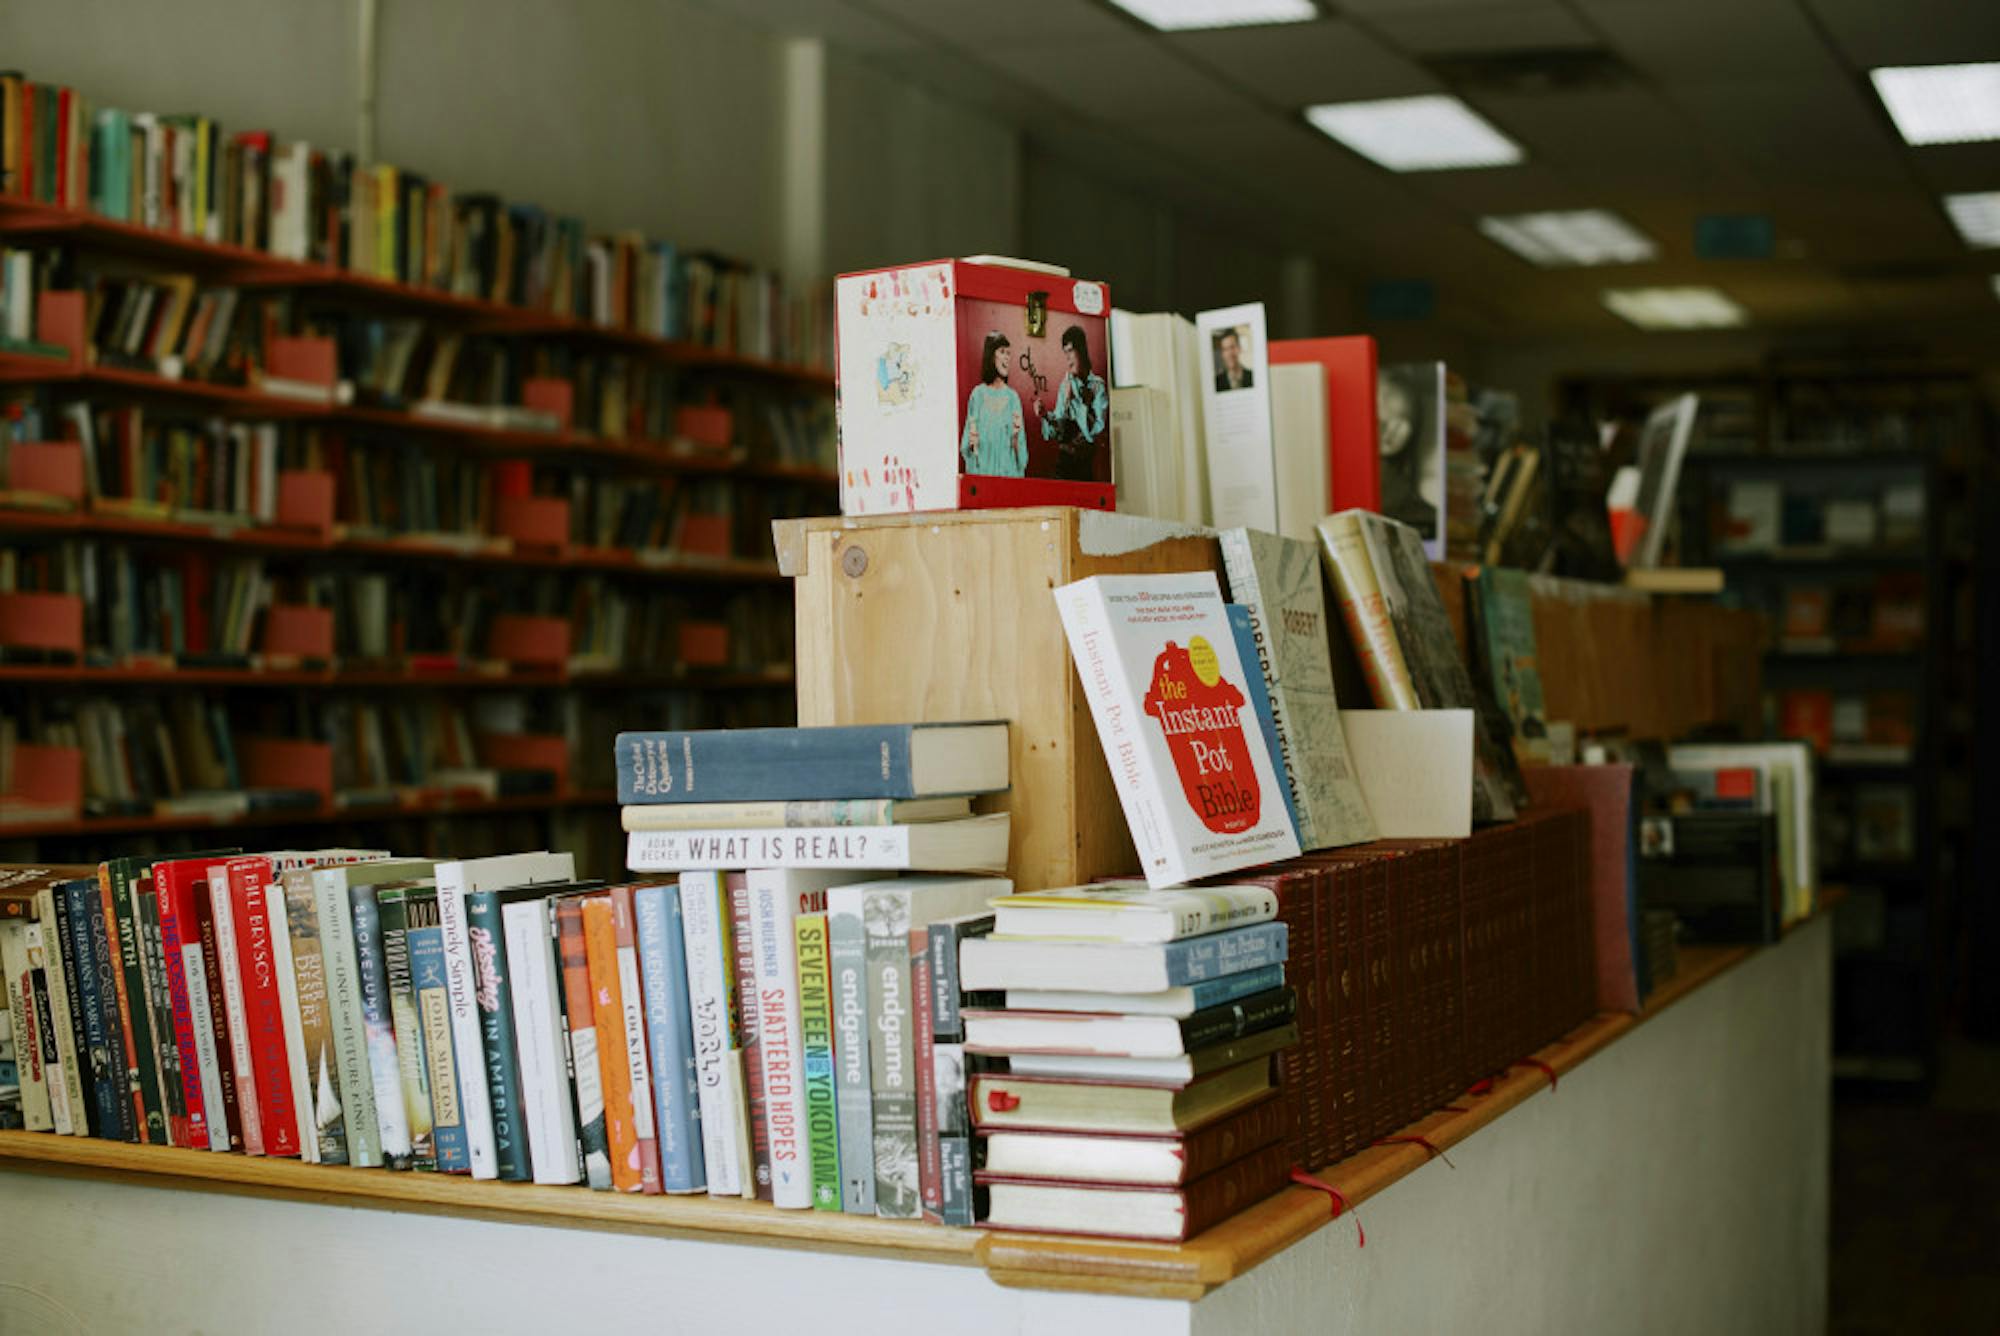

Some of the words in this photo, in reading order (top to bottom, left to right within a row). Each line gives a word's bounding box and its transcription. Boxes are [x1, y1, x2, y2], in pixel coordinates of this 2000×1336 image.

[1082, 630, 1114, 699] Instant
[1106, 704, 1125, 737] Pot
[1159, 673, 1187, 700] the
[1156, 700, 1240, 736] Instant
[1189, 740, 1233, 776] Pot
[1196, 781, 1256, 819] Bible
[689, 837, 749, 860] WHAT
[762, 837, 783, 859] IS
[796, 836, 868, 860] REAL?
[244, 873, 262, 910] BILL
[733, 887, 748, 917] OUR
[758, 888, 774, 919] JOSH
[92, 913, 106, 958] GLASS
[119, 918, 137, 967] MYTH
[163, 915, 180, 945] THE
[642, 899, 659, 945] ANNA
[735, 920, 752, 954] KIND
[249, 916, 270, 989] BRYSON
[442, 886, 460, 957] Insanely
[452, 959, 466, 1019] Simple
[740, 956, 753, 974] OF
[760, 920, 778, 977] RUEBNER
[98, 962, 114, 1018] CASTLE
[168, 952, 190, 1027] POSSIBLE
[296, 956, 317, 1028] DESERT
[310, 952, 323, 1001] RIVER
[336, 967, 351, 1008] ONCE
[649, 949, 668, 1026] KENDRICK
[799, 928, 828, 1059] SEVENTEEN
[85, 994, 101, 1042] MARCH
[487, 1019, 499, 1041] IN
[740, 978, 758, 1035] CRUELTY
[838, 967, 861, 1084] endgame
[878, 965, 906, 1088] endgame
[180, 1033, 201, 1099] HUMAN
[344, 1027, 361, 1089] FUTURE
[430, 993, 444, 1038] JOHN
[437, 1051, 452, 1121] MILTON
[697, 997, 721, 1088] WORLD
[762, 989, 791, 1097] SHATTERED
[222, 1071, 234, 1104] MAIN
[351, 1093, 364, 1131] KING
[489, 1051, 510, 1150] AMERICA
[771, 1101, 797, 1162] HOPES
[954, 1153, 964, 1168] In
[955, 1170, 966, 1191] the
